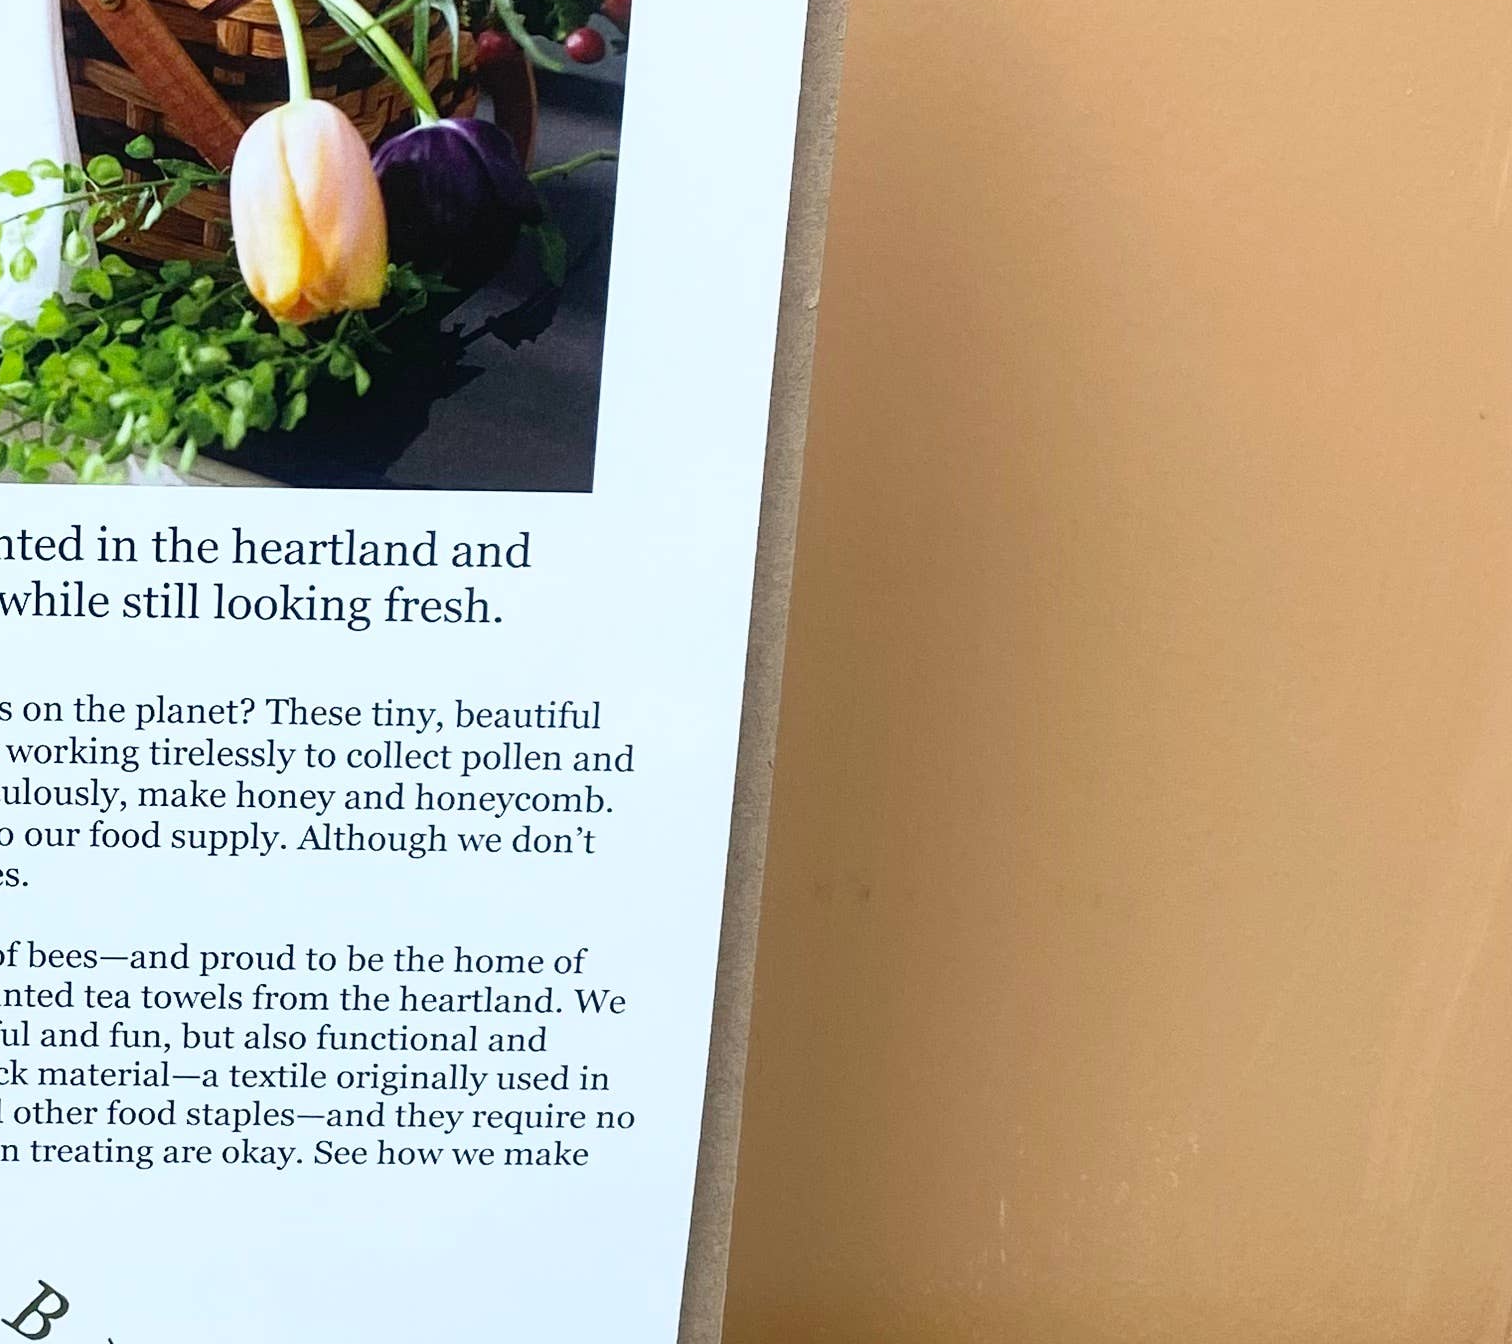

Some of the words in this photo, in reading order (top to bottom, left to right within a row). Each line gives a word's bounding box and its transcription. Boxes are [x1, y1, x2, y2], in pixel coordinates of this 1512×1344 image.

[96, 524, 139, 563] in
[151, 525, 219, 564] the
[231, 526, 439, 567] heartland
[451, 531, 532, 569] and
[122, 582, 200, 619] still
[213, 582, 372, 632] looking
[383, 585, 503, 624] fresh.
[22, 701, 64, 722] on
[72, 693, 126, 724] the
[134, 694, 256, 731] planet?
[265, 696, 362, 727] These
[371, 698, 444, 735] tiny,
[455, 699, 601, 730] beautiful
[5, 735, 140, 773] working
[148, 737, 297, 775] tirelessly
[303, 743, 336, 769] to
[346, 740, 453, 770] collect
[460, 741, 563, 778] pollen
[573, 744, 635, 773] and
[137, 779, 227, 809] make
[235, 779, 337, 817] honey
[344, 781, 406, 811] and
[414, 782, 613, 819] honeycomb.
[24, 827, 81, 847] our
[89, 819, 161, 849] food
[171, 821, 287, 857] supply.
[296, 822, 448, 860] Although
[457, 833, 502, 853] we
[83, 985, 132, 1009] tea
[140, 982, 243, 1011] towels
[252, 983, 329, 1011] from
[339, 984, 390, 1012] the
[399, 984, 563, 1014] heartland.
[573, 988, 626, 1015] We
[40, 1020, 100, 1048] and
[108, 1021, 171, 1054] fun,
[181, 1021, 235, 1050] but
[243, 1022, 307, 1050] also
[316, 1023, 478, 1052] functional
[487, 1025, 547, 1053] and
[29, 1137, 154, 1170] treating
[163, 1145, 213, 1164] are
[221, 1138, 303, 1171] okay.
[314, 1140, 368, 1165] See
[376, 1139, 445, 1166] how
[451, 1148, 495, 1166] we
[503, 1140, 589, 1167] make
